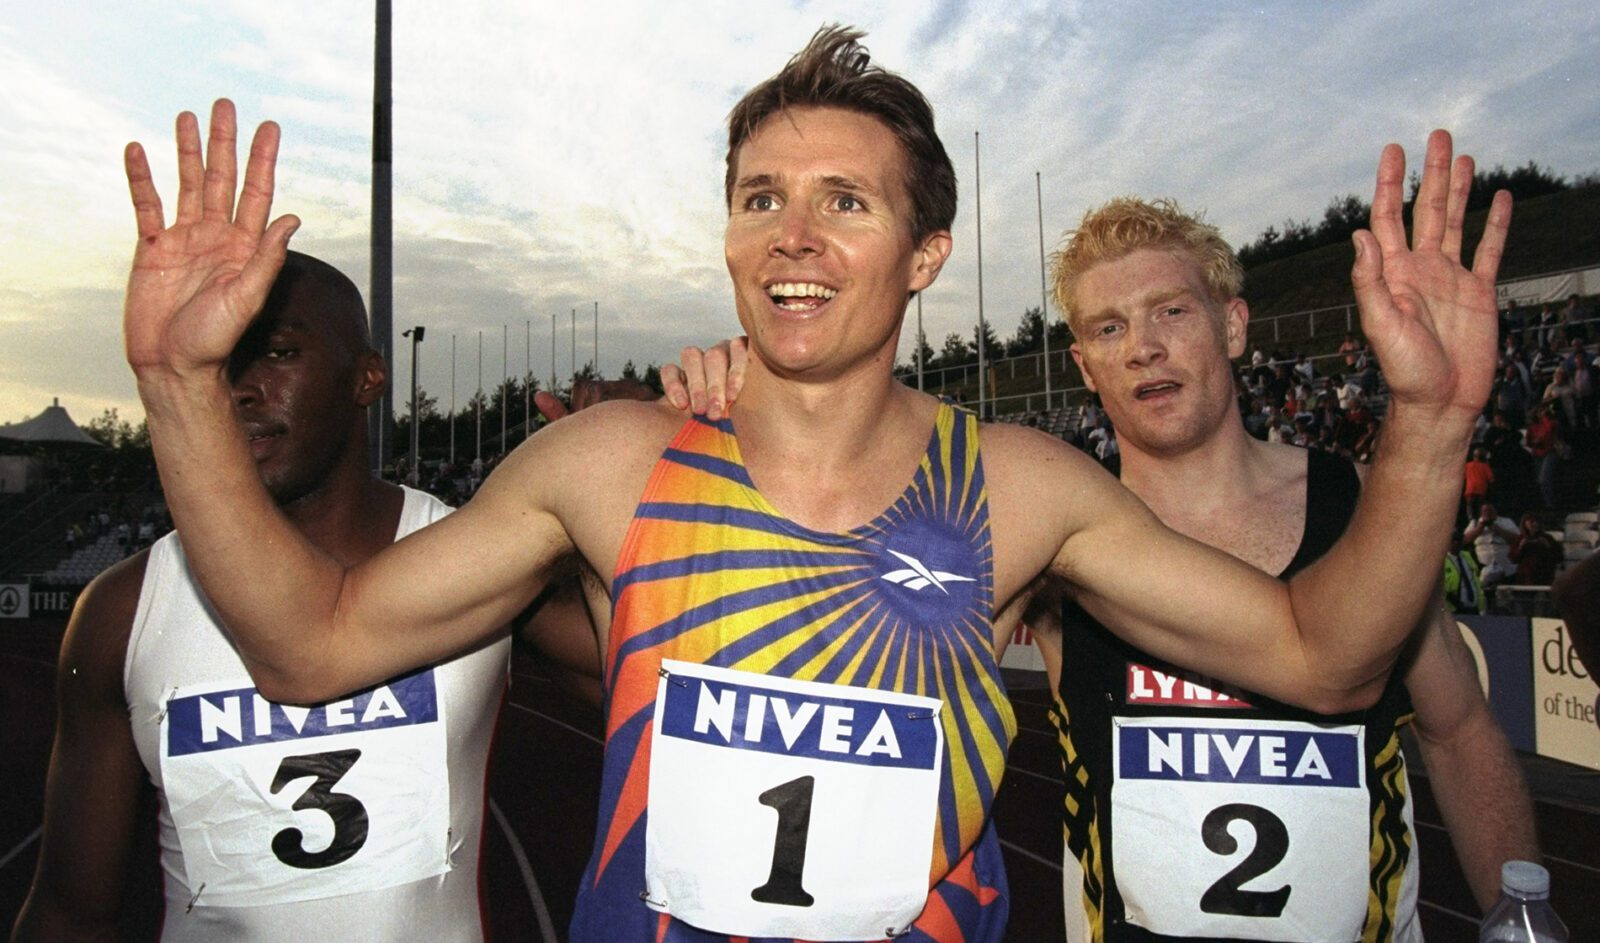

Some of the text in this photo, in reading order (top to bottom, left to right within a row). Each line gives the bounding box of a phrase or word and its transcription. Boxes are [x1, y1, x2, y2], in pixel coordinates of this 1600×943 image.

[32, 592, 70, 610] THE
[693, 680, 902, 759] NIVEA
[1544, 693, 1595, 723] of the
[1148, 728, 1332, 780] NIVEA
[270, 748, 369, 869] 3
[750, 775, 815, 907] 1
[1200, 803, 1291, 918] 2
